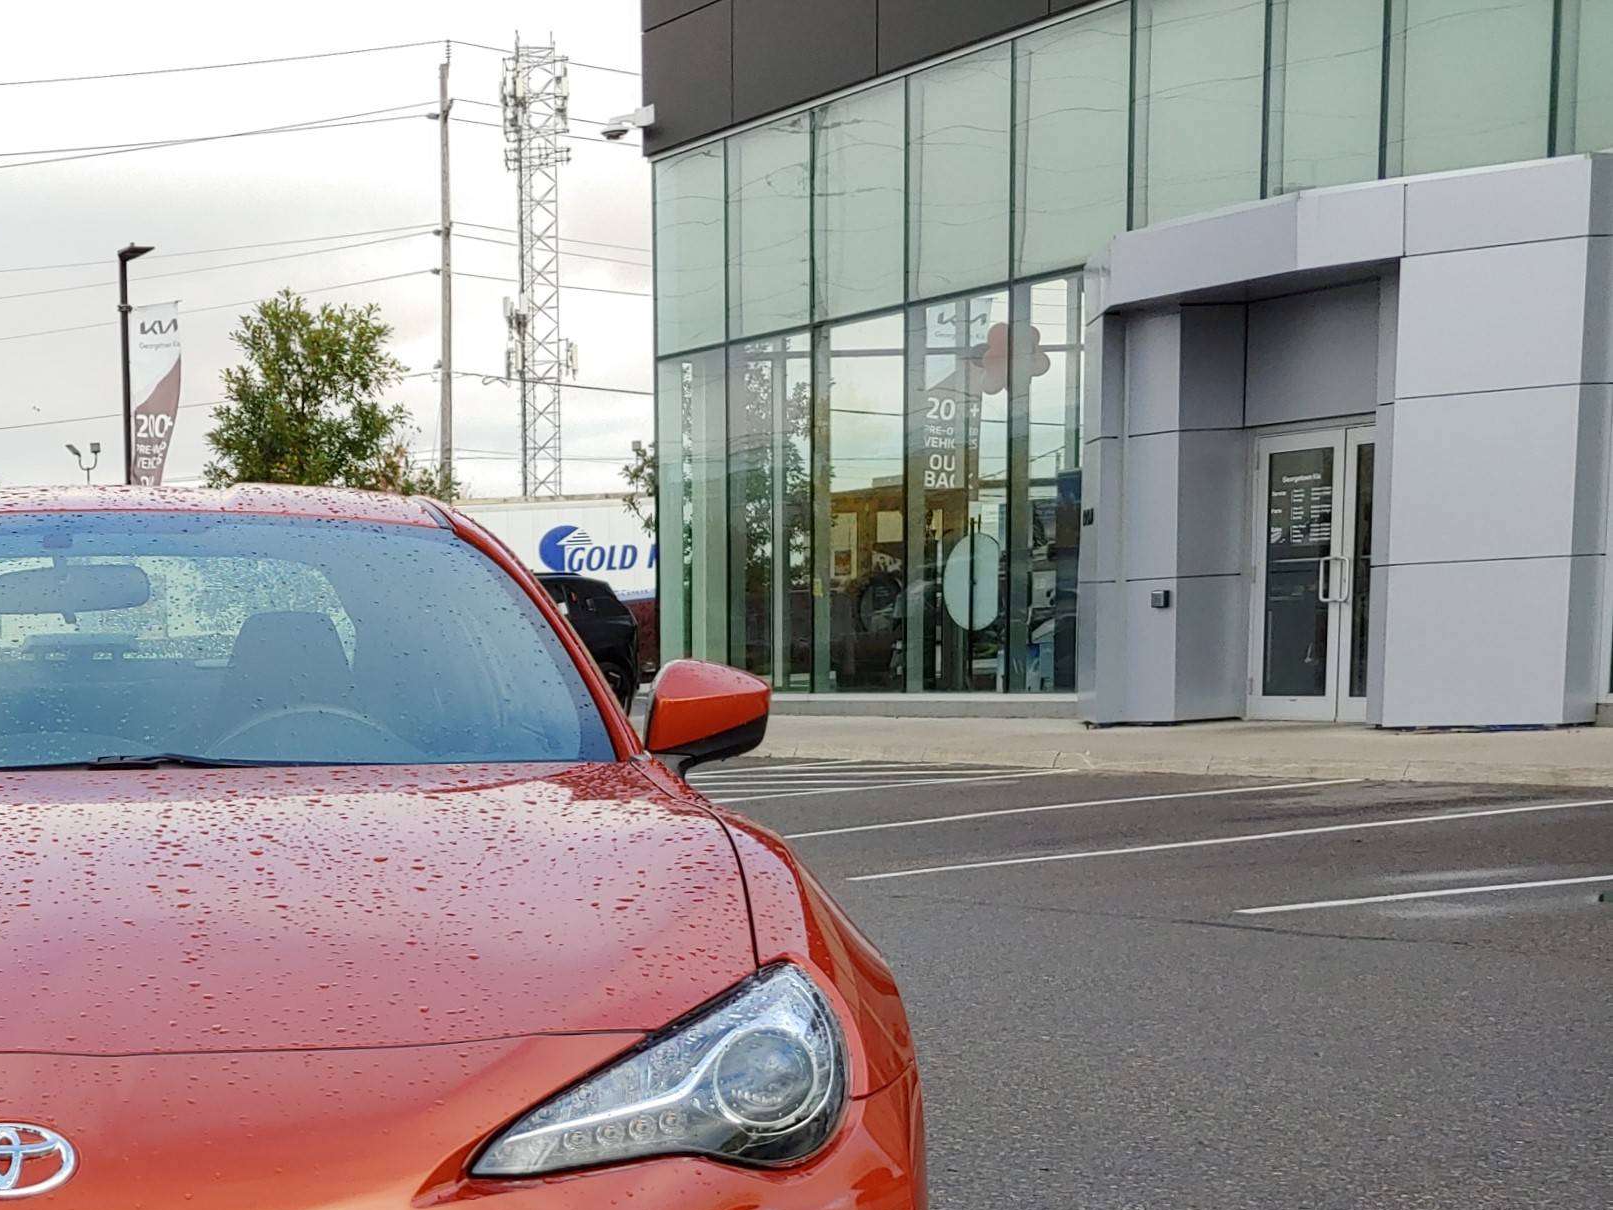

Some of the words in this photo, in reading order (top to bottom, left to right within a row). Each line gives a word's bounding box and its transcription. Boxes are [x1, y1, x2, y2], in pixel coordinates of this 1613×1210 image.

[140, 318, 178, 335] KIA
[926, 397, 979, 420] 20+
[568, 544, 637, 572] GOLD
